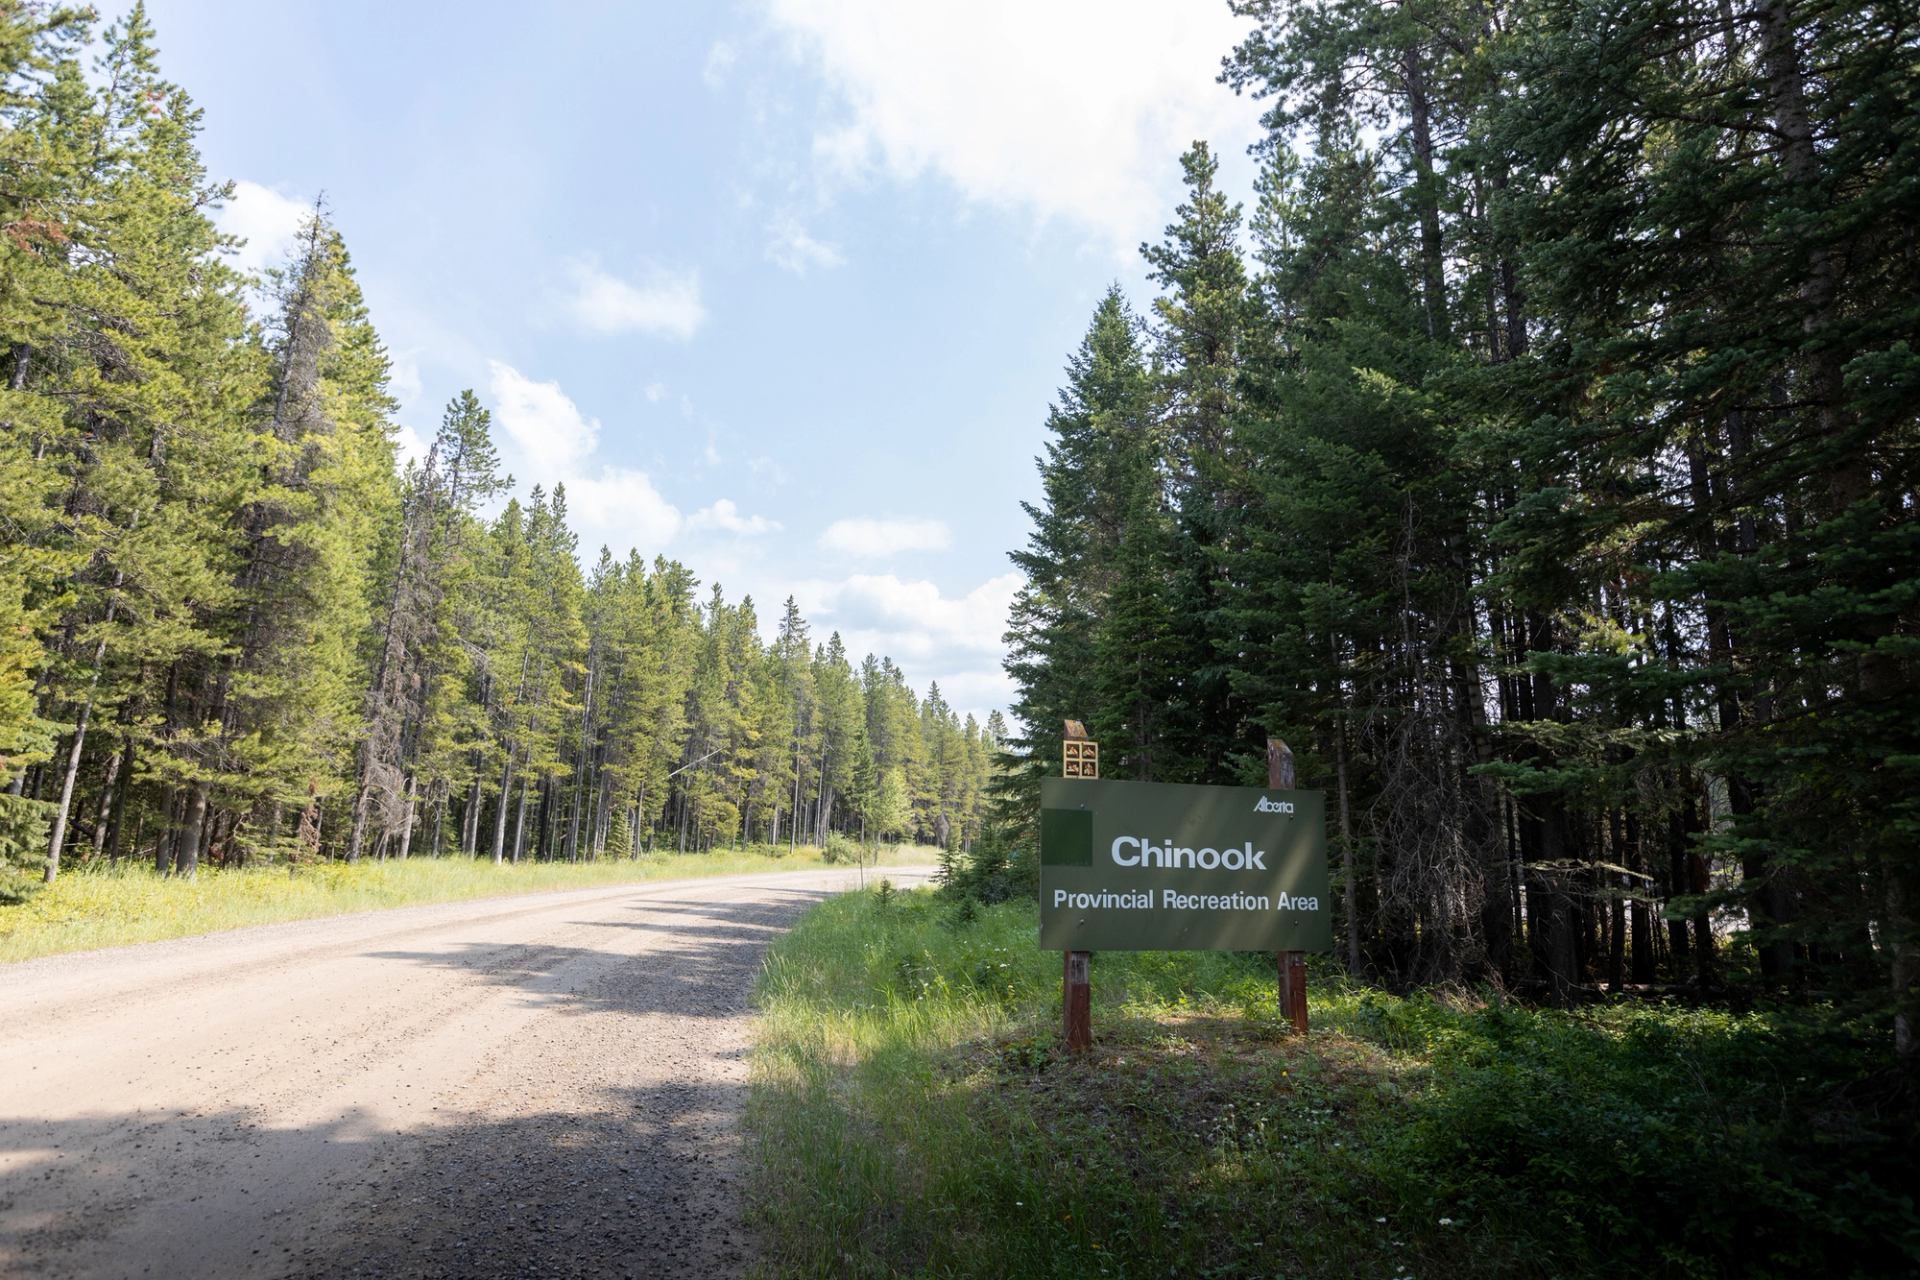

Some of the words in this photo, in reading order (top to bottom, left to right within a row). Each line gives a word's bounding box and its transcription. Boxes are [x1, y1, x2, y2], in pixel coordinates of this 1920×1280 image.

[1253, 795, 1294, 814] Alberta
[1111, 836, 1267, 870] Chinook
[1054, 889, 1154, 909] Provincial
[1163, 889, 1269, 910] Recreation
[1277, 891, 1319, 911] Area
